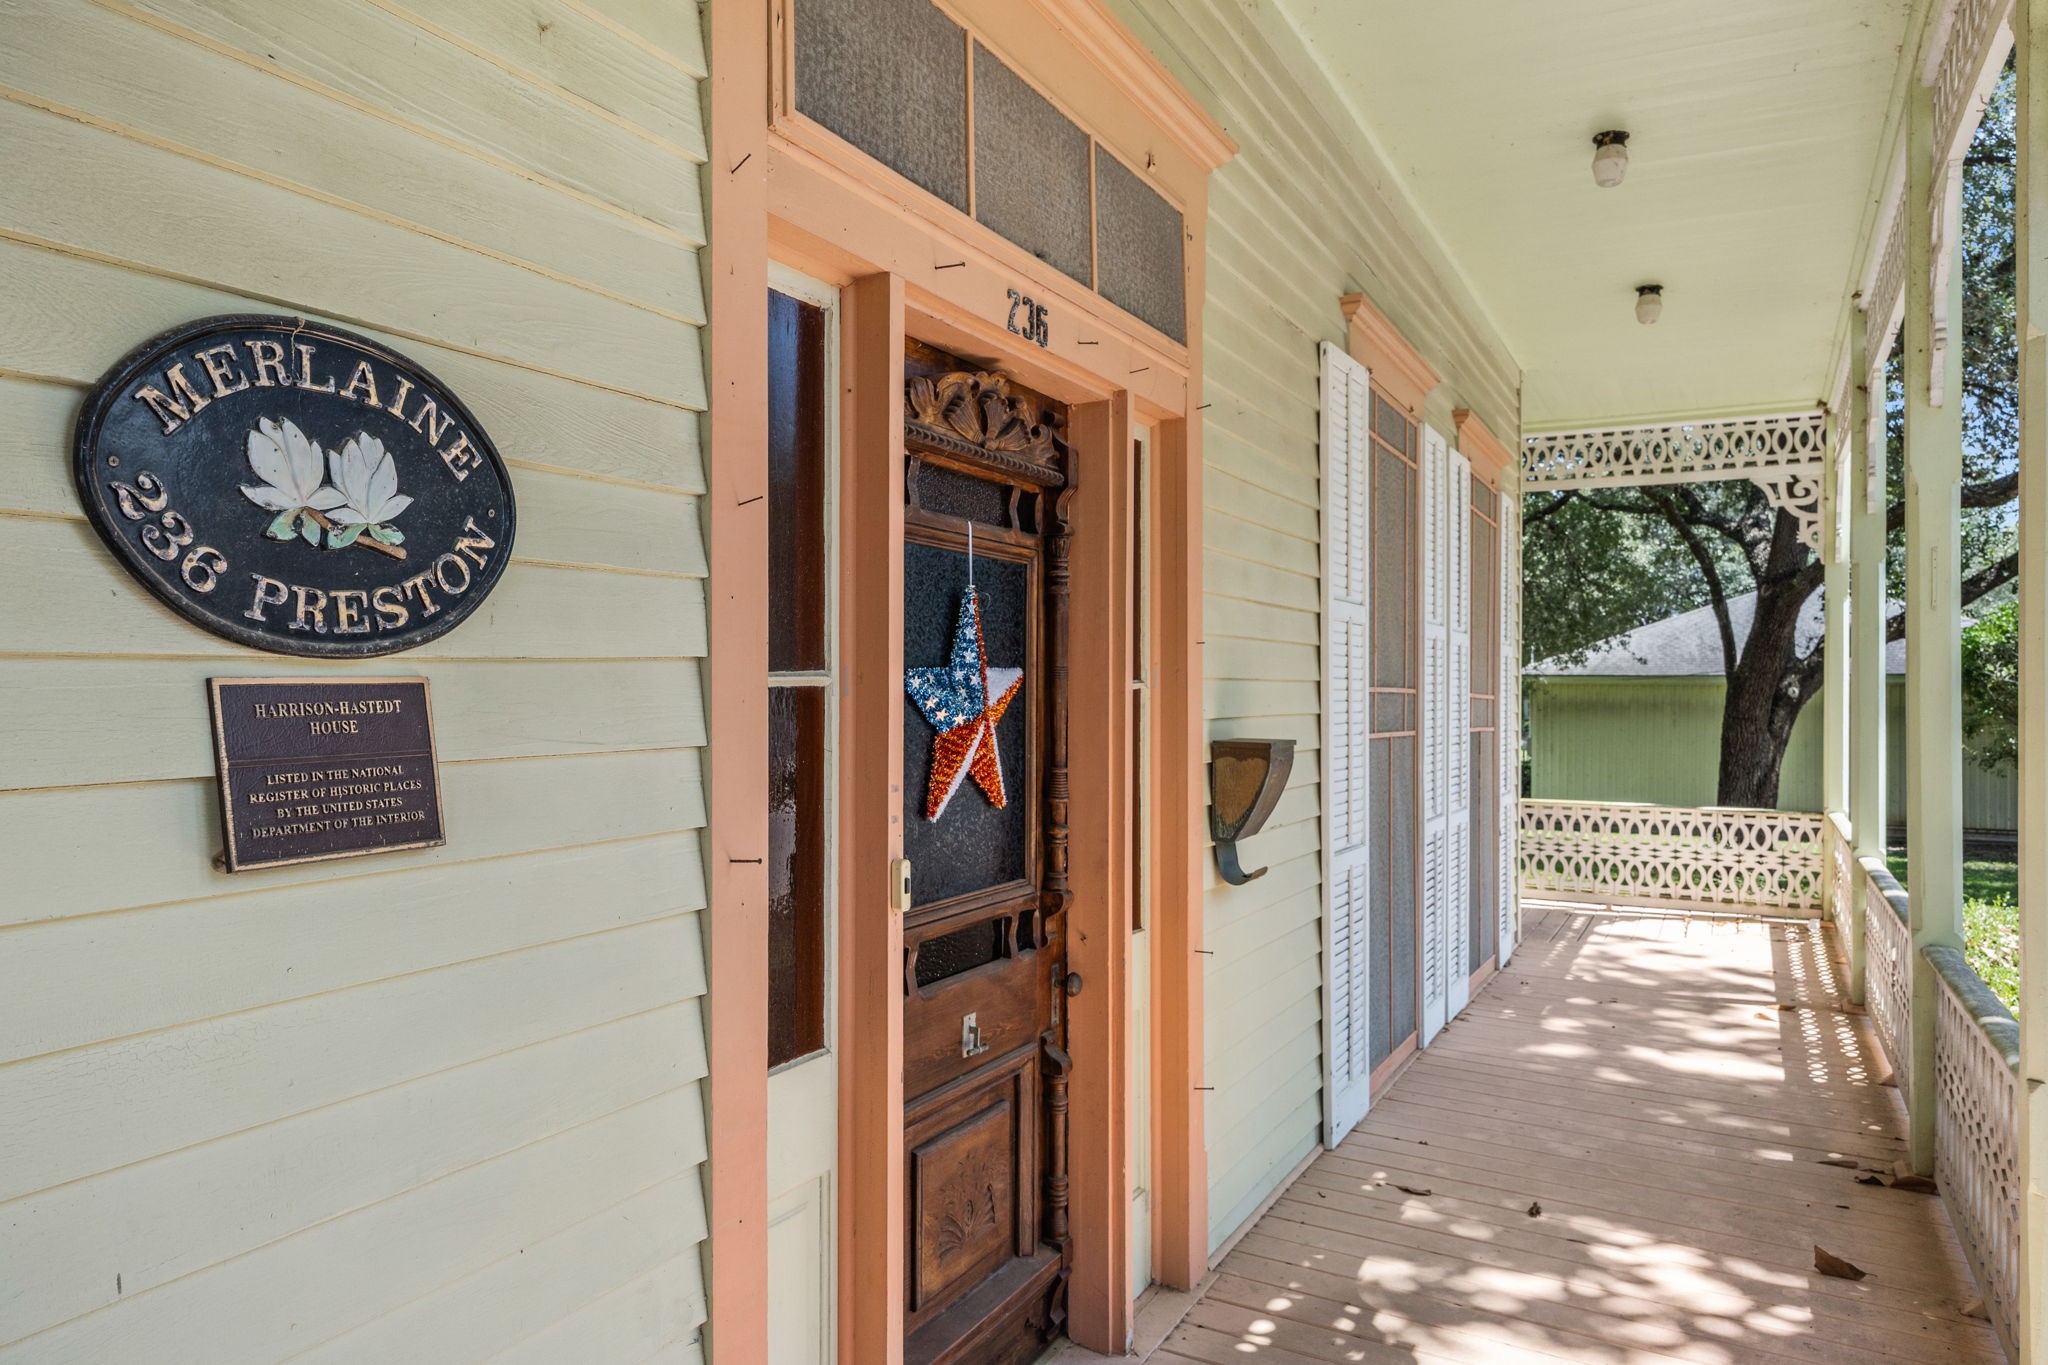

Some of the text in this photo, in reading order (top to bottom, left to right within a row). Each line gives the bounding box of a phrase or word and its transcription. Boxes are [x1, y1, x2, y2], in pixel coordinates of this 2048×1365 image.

[1007, 288, 1049, 348] 236
[133, 339, 484, 483] MERLAINE
[110, 470, 497, 634] 236 PRESTON
[254, 699, 402, 718] HARRISON-HASTEDT
[310, 720, 359, 735] HOUSE
[267, 765, 404, 785] LISTED IN THE NATIONAL
[249, 780, 422, 804] REGISTER OF HISTORIC PLACES
[277, 797, 403, 818] BY THE UNITED STATES
[252, 811, 425, 839] DEPARTMENT OF THE INTERIOR
